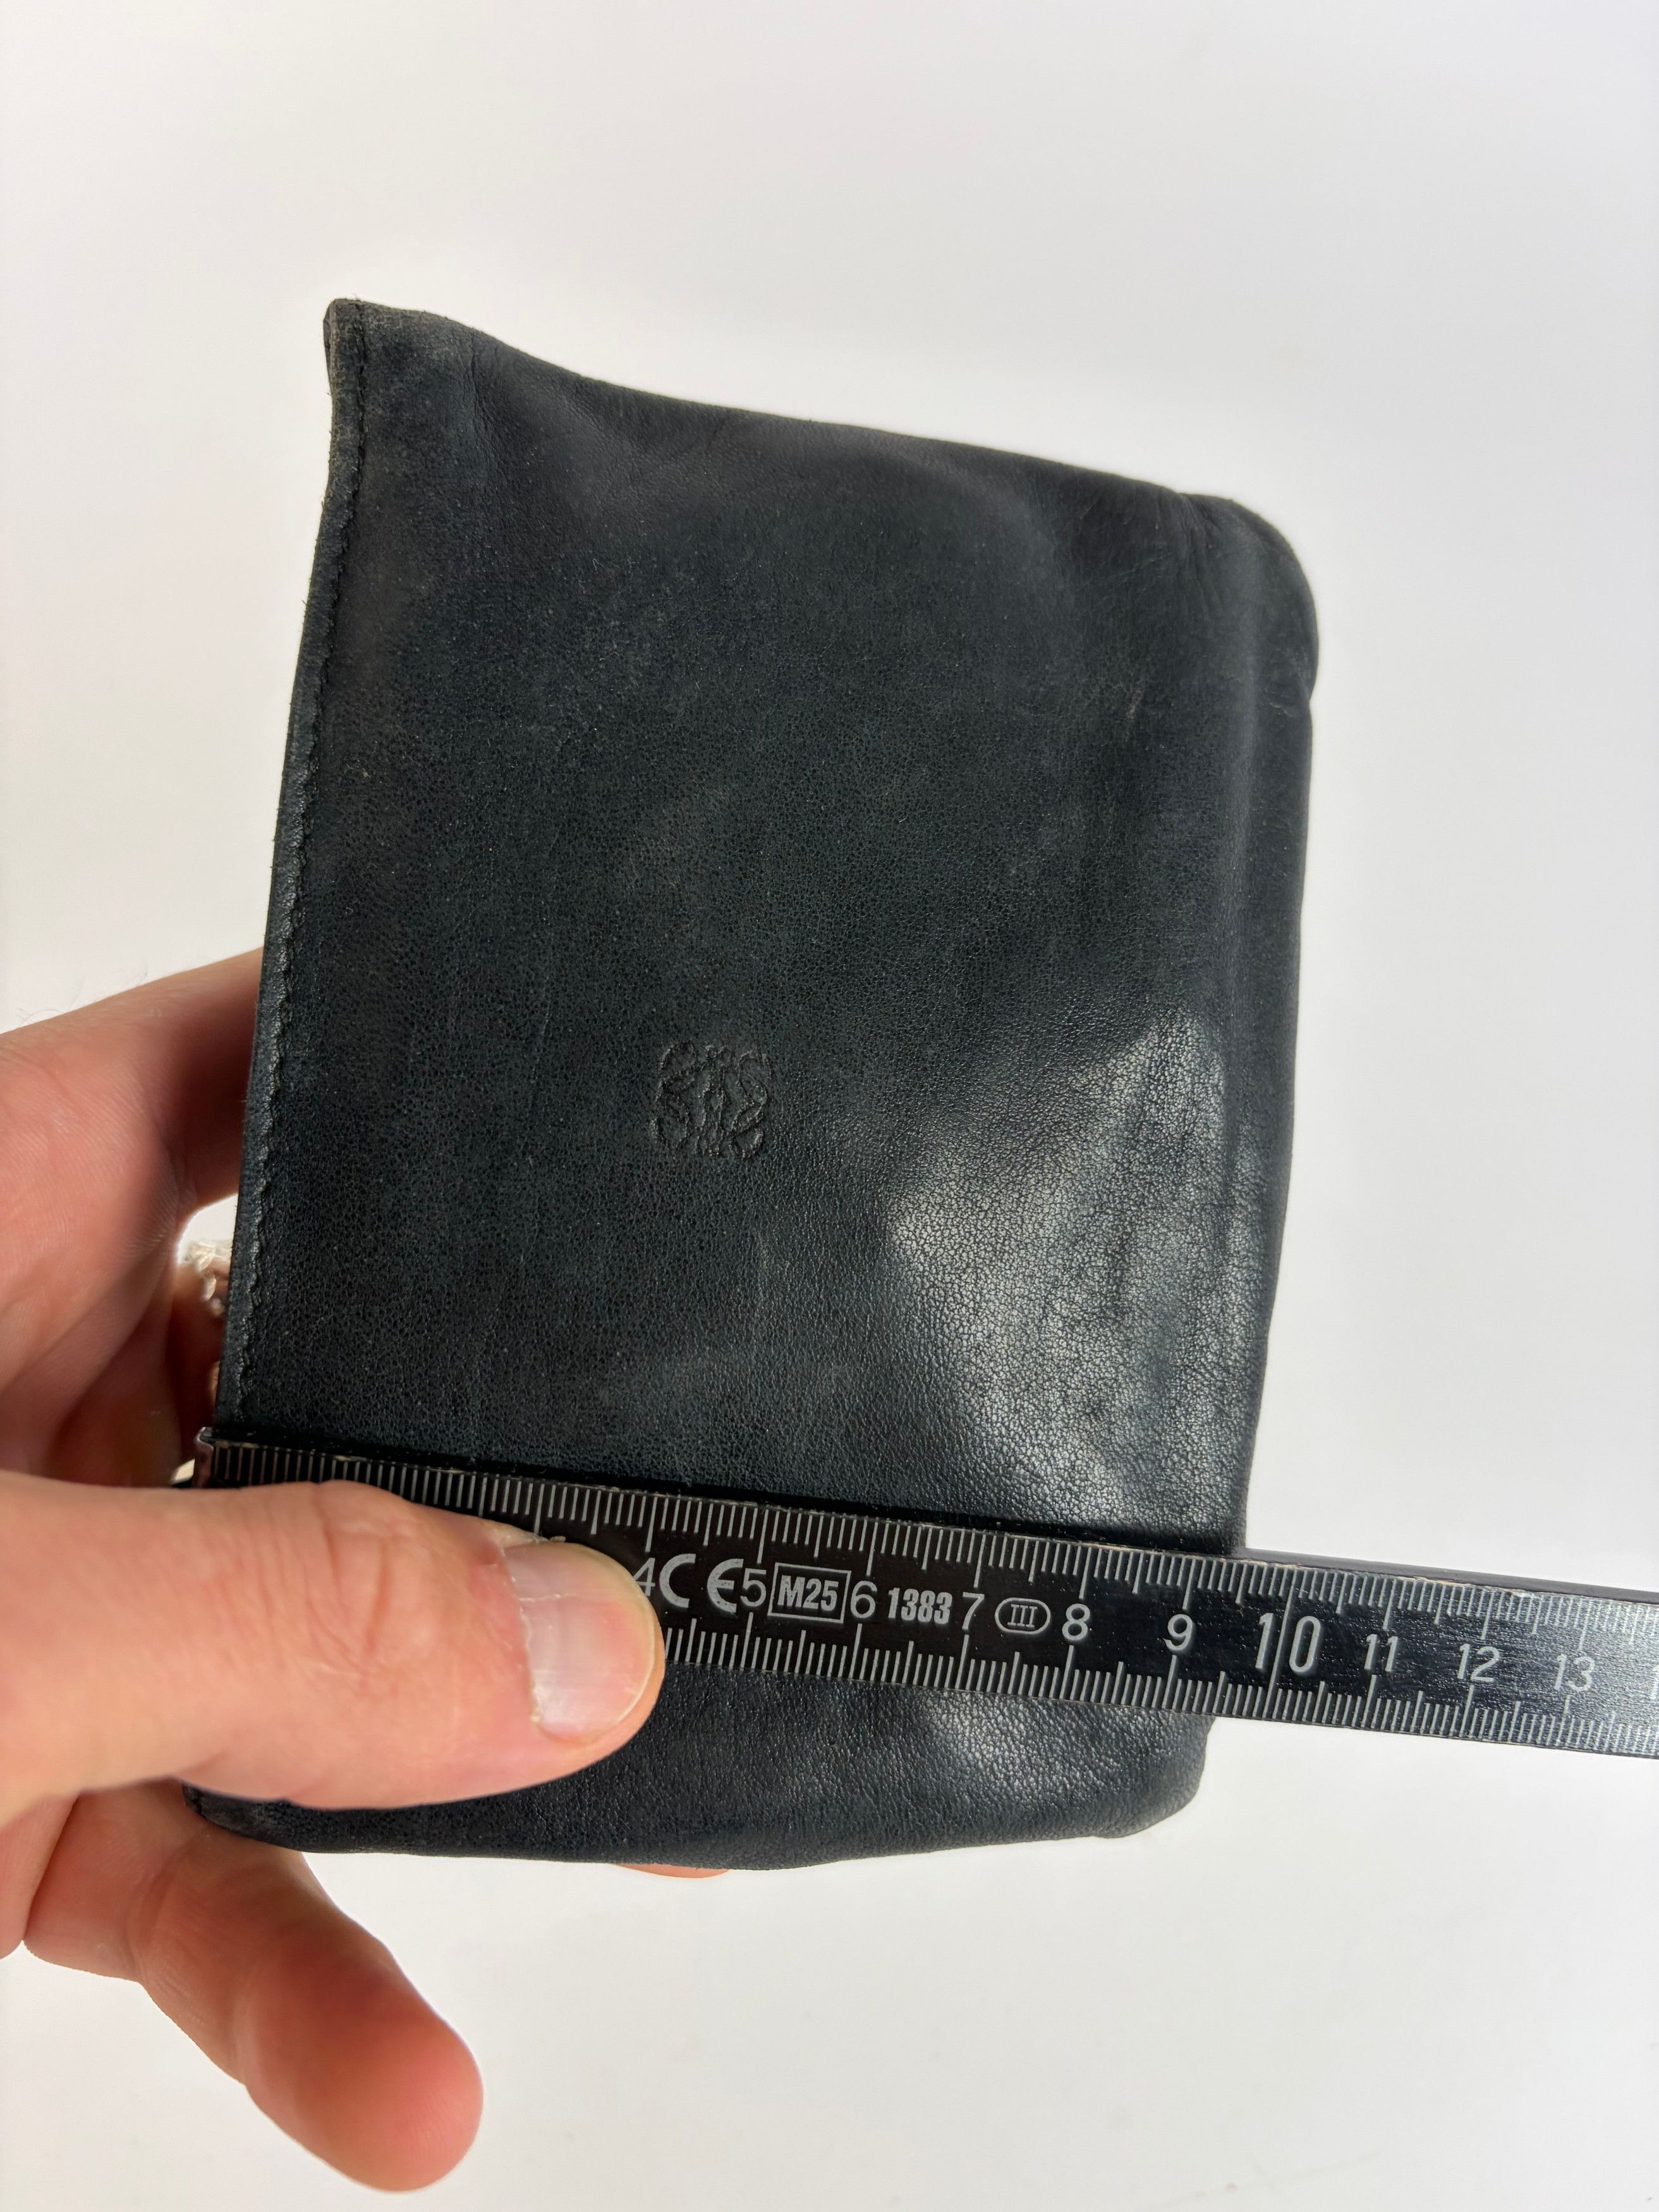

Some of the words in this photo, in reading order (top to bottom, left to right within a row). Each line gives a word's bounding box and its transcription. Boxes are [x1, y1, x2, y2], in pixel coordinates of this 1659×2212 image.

[632, 1557, 655, 1596] 4
[740, 1568, 767, 1607] 5
[777, 1575, 839, 1612] M25
[850, 1581, 877, 1619] 6
[887, 1588, 952, 1625] 1383
[962, 1593, 985, 1631] 7
[1062, 1603, 1091, 1641] 8
[1164, 1613, 1194, 1653] 9
[1256, 1612, 1322, 1674] 10
[1364, 1634, 1399, 1672] 11
[1457, 1643, 1500, 1683] 12
[1553, 1653, 1597, 1692] 13
